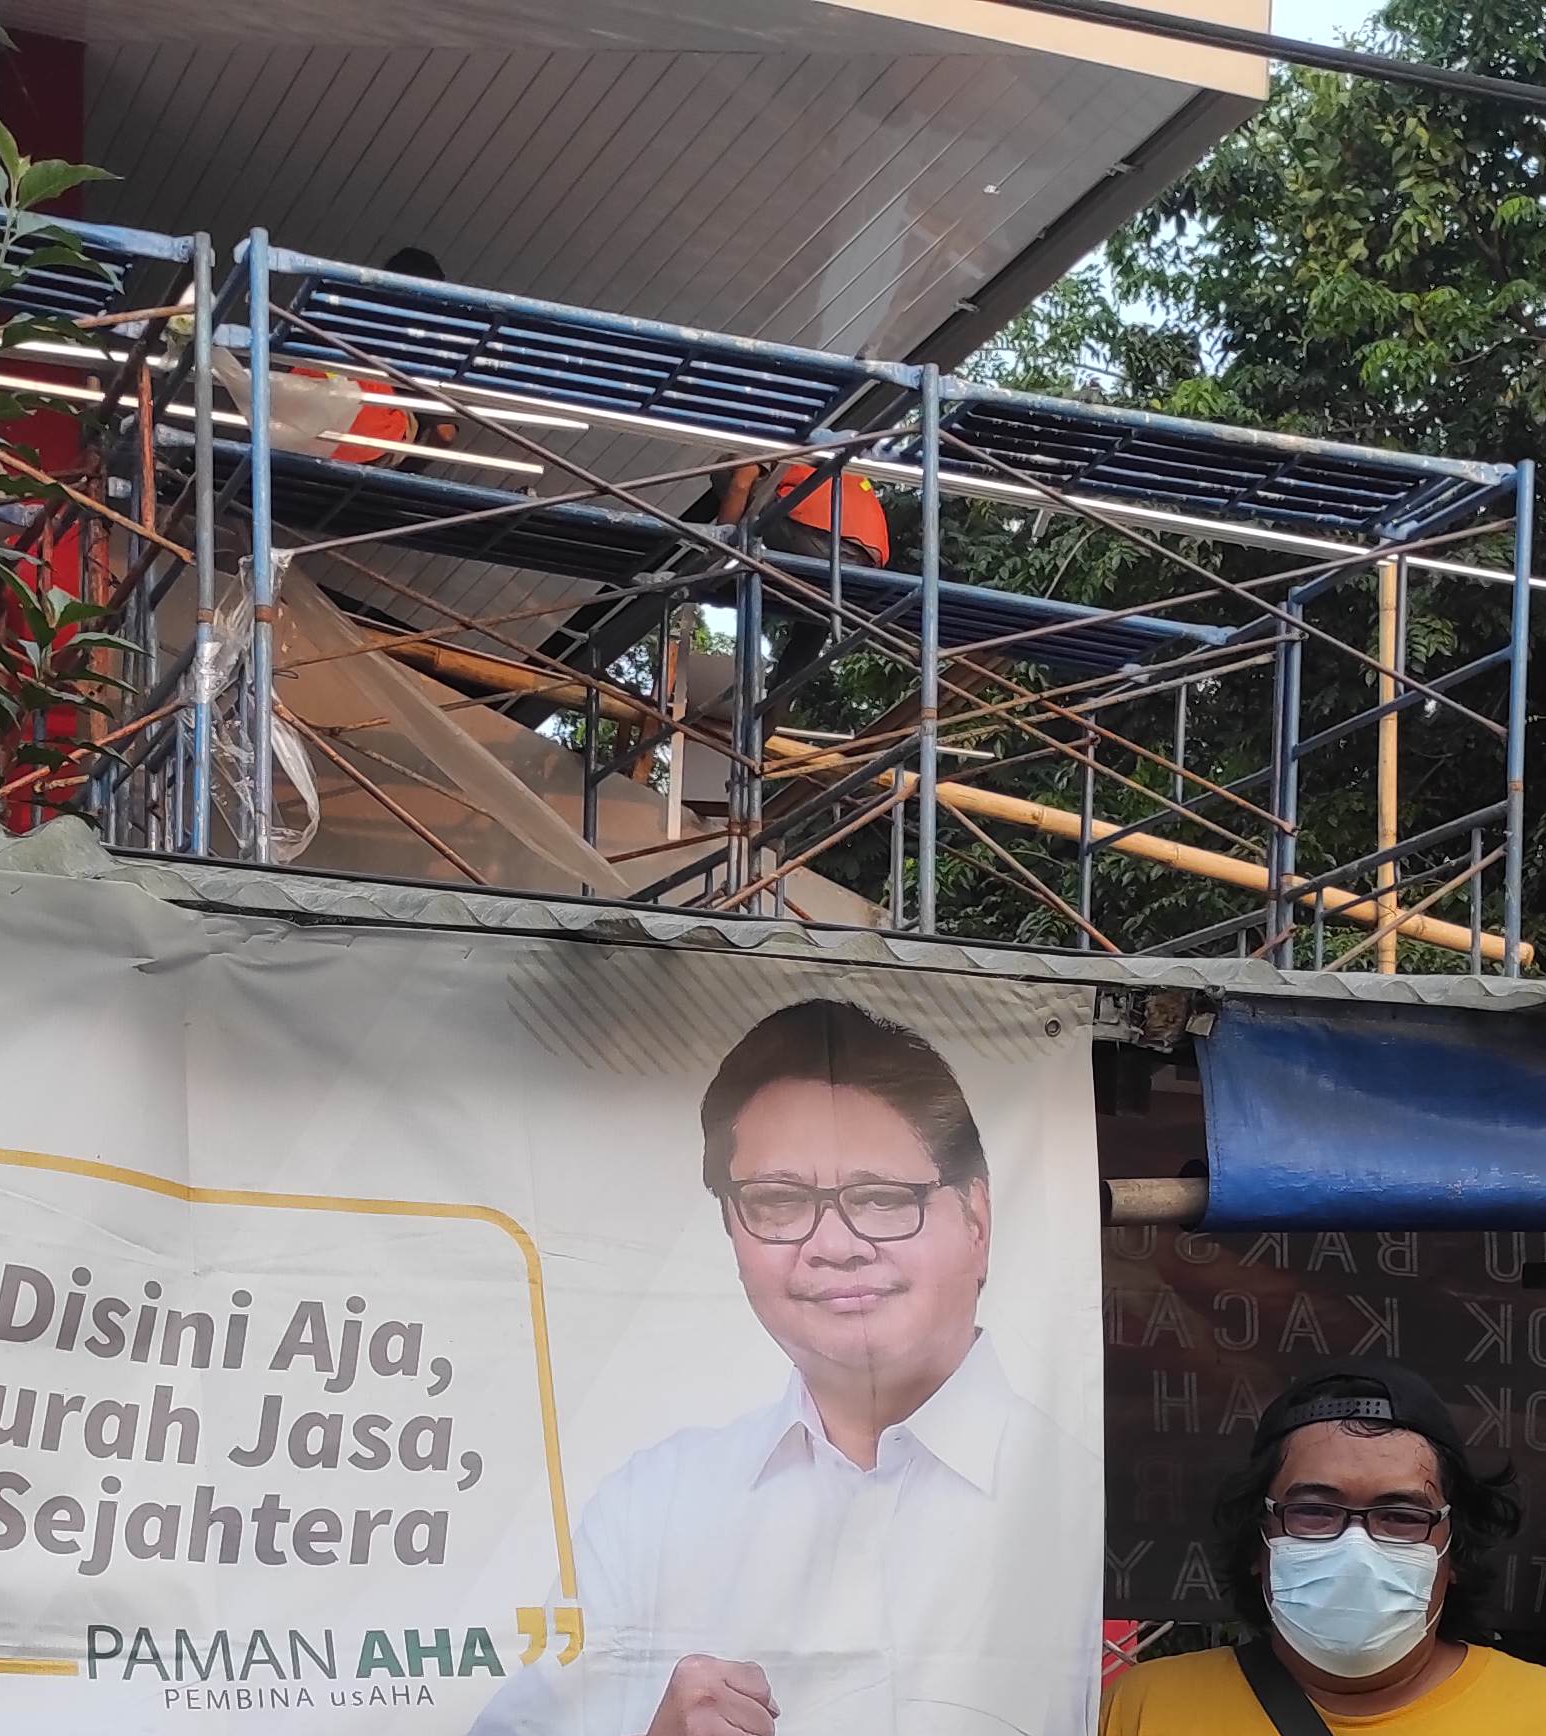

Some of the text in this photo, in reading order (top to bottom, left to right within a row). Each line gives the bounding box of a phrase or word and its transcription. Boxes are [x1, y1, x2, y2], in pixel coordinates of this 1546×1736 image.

[268, 1294, 455, 1400] Aja,
[227, 1393, 485, 1491] Jasa,
[84, 1623, 507, 1683] PAMAN AHA
[163, 1684, 436, 1711] PEMBINA usAHA
